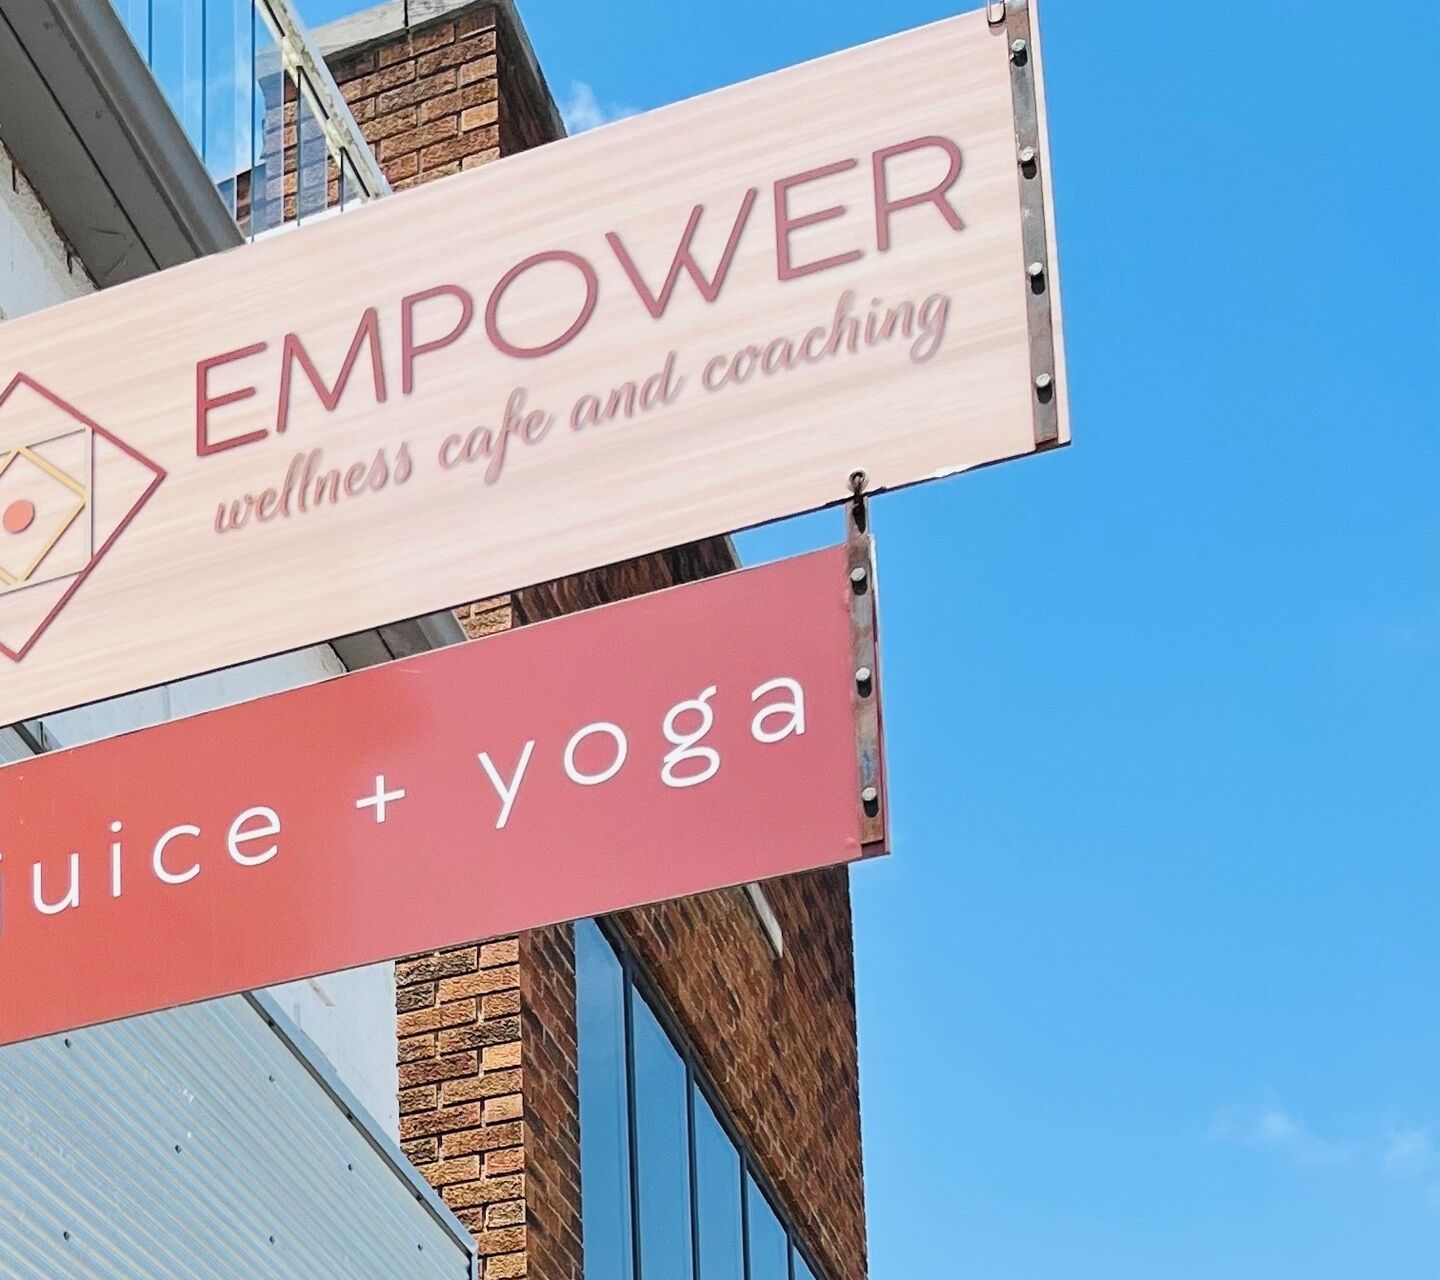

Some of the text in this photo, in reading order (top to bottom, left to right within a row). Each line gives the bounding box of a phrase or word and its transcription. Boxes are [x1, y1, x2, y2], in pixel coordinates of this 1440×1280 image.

[195, 133, 967, 458] EMPOWER
[214, 286, 951, 536] wellness cafe and coaching
[355, 774, 407, 824] +
[477, 675, 809, 830] yoga
